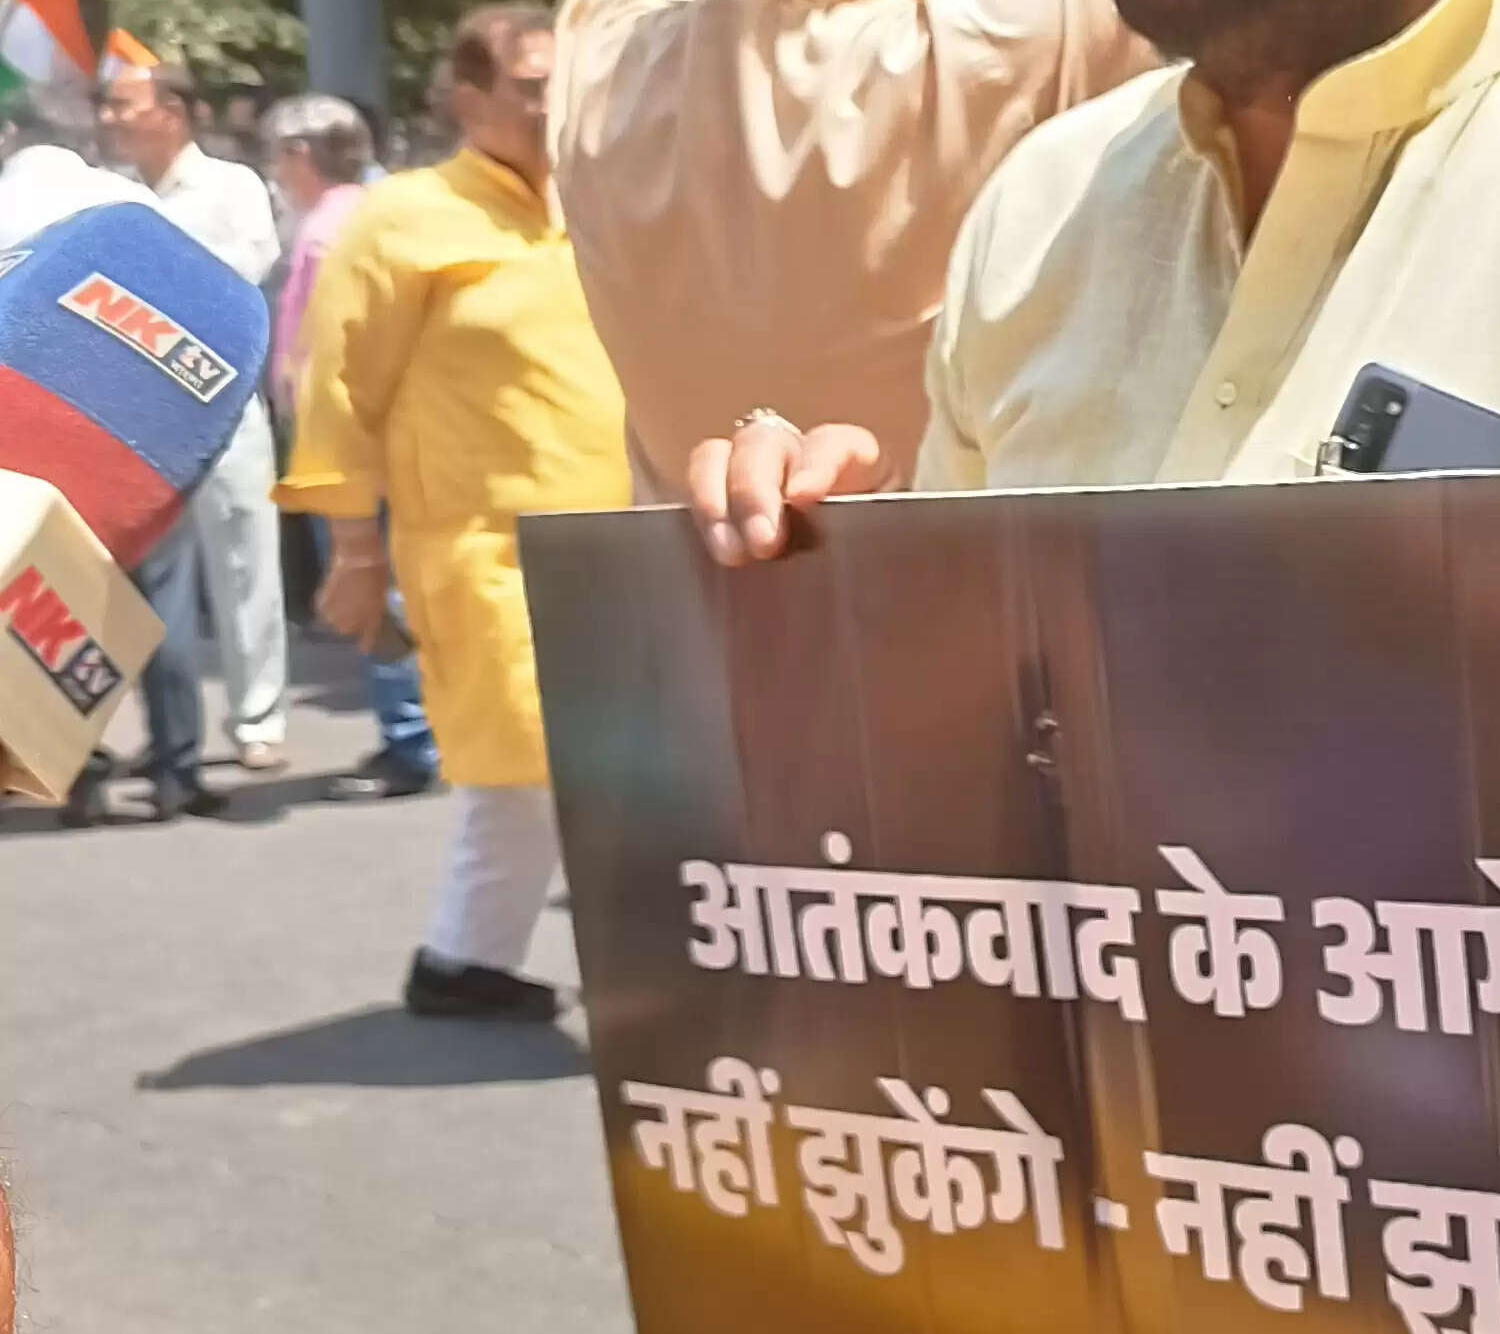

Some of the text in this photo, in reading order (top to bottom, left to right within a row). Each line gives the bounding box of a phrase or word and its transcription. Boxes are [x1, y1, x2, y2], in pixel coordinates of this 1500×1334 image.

[71, 279, 180, 355] NK
[0, 564, 87, 670] NK
[680, 830, 1147, 1022] आतंकवाद
[1154, 844, 1285, 1018] के
[620, 1055, 781, 1218] नहीं
[785, 1076, 1066, 1276] झुकेंगे
[1143, 1123, 1364, 1313] नहीं
